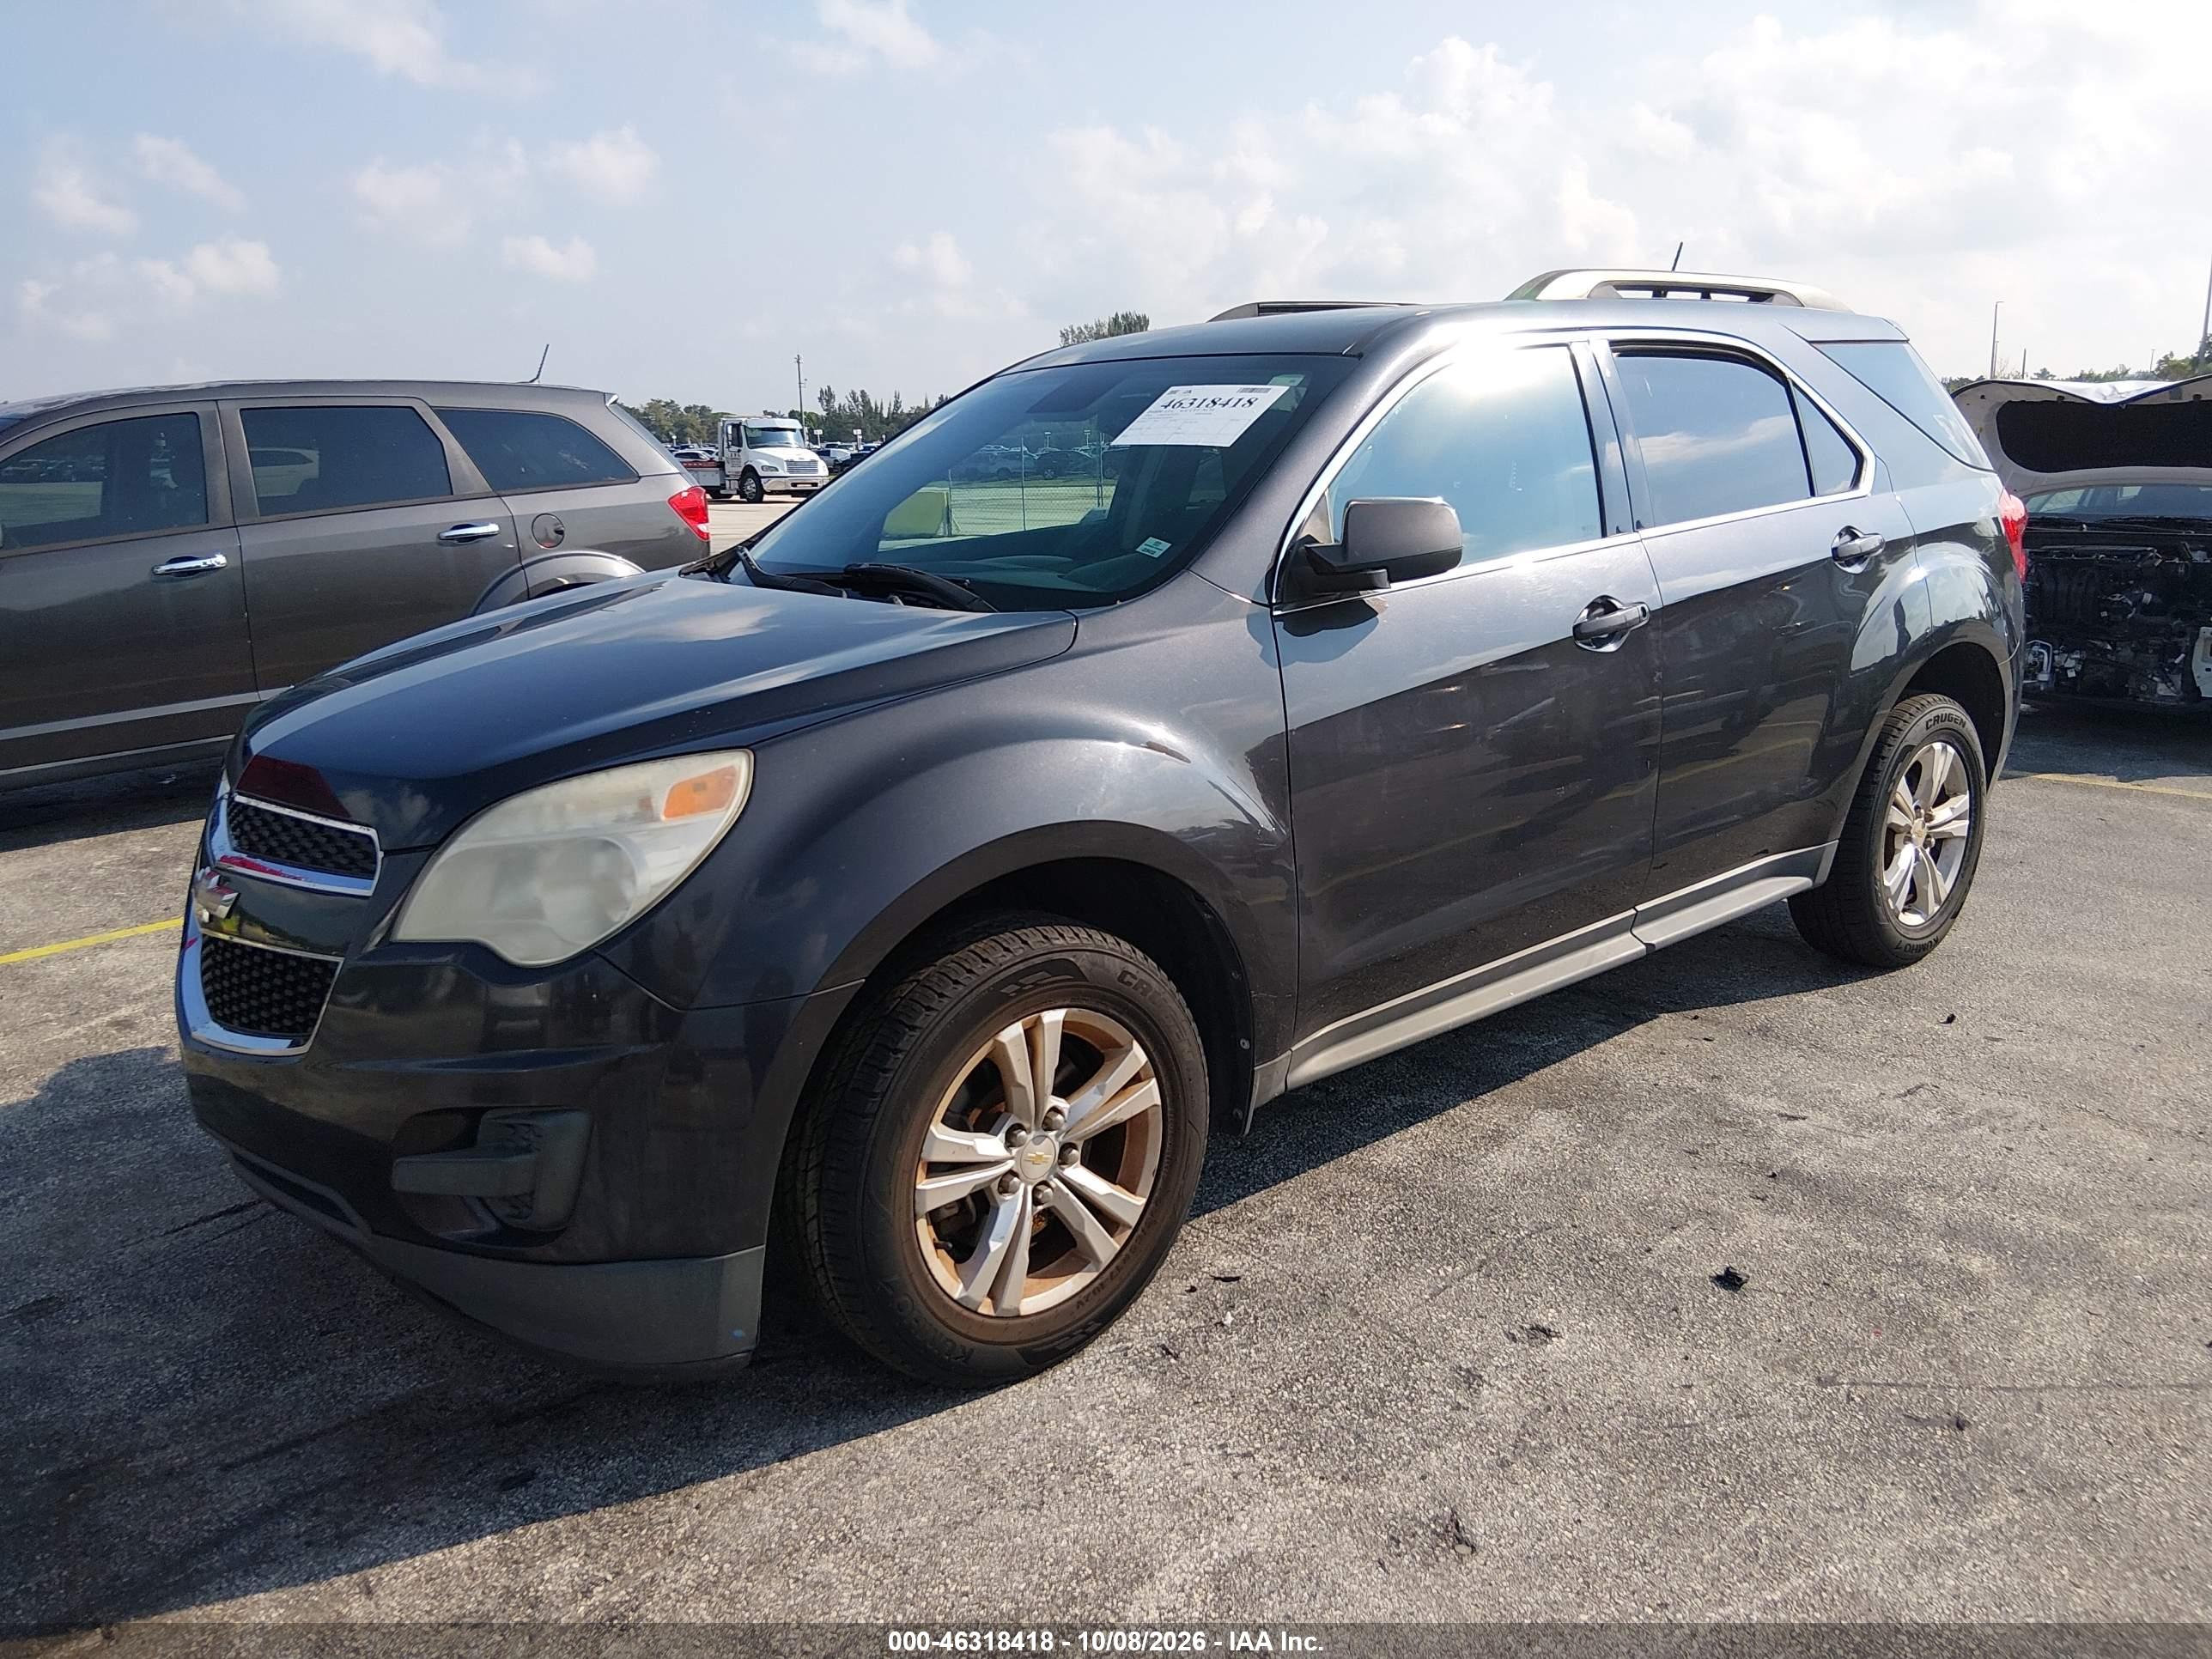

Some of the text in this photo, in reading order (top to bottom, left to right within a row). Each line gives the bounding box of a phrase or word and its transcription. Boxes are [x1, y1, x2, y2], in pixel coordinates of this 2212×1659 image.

[1161, 397, 1259, 410] 46318418
[1925, 713, 1966, 731] CRUGEN
[1904, 935, 1939, 954] KUMHO
